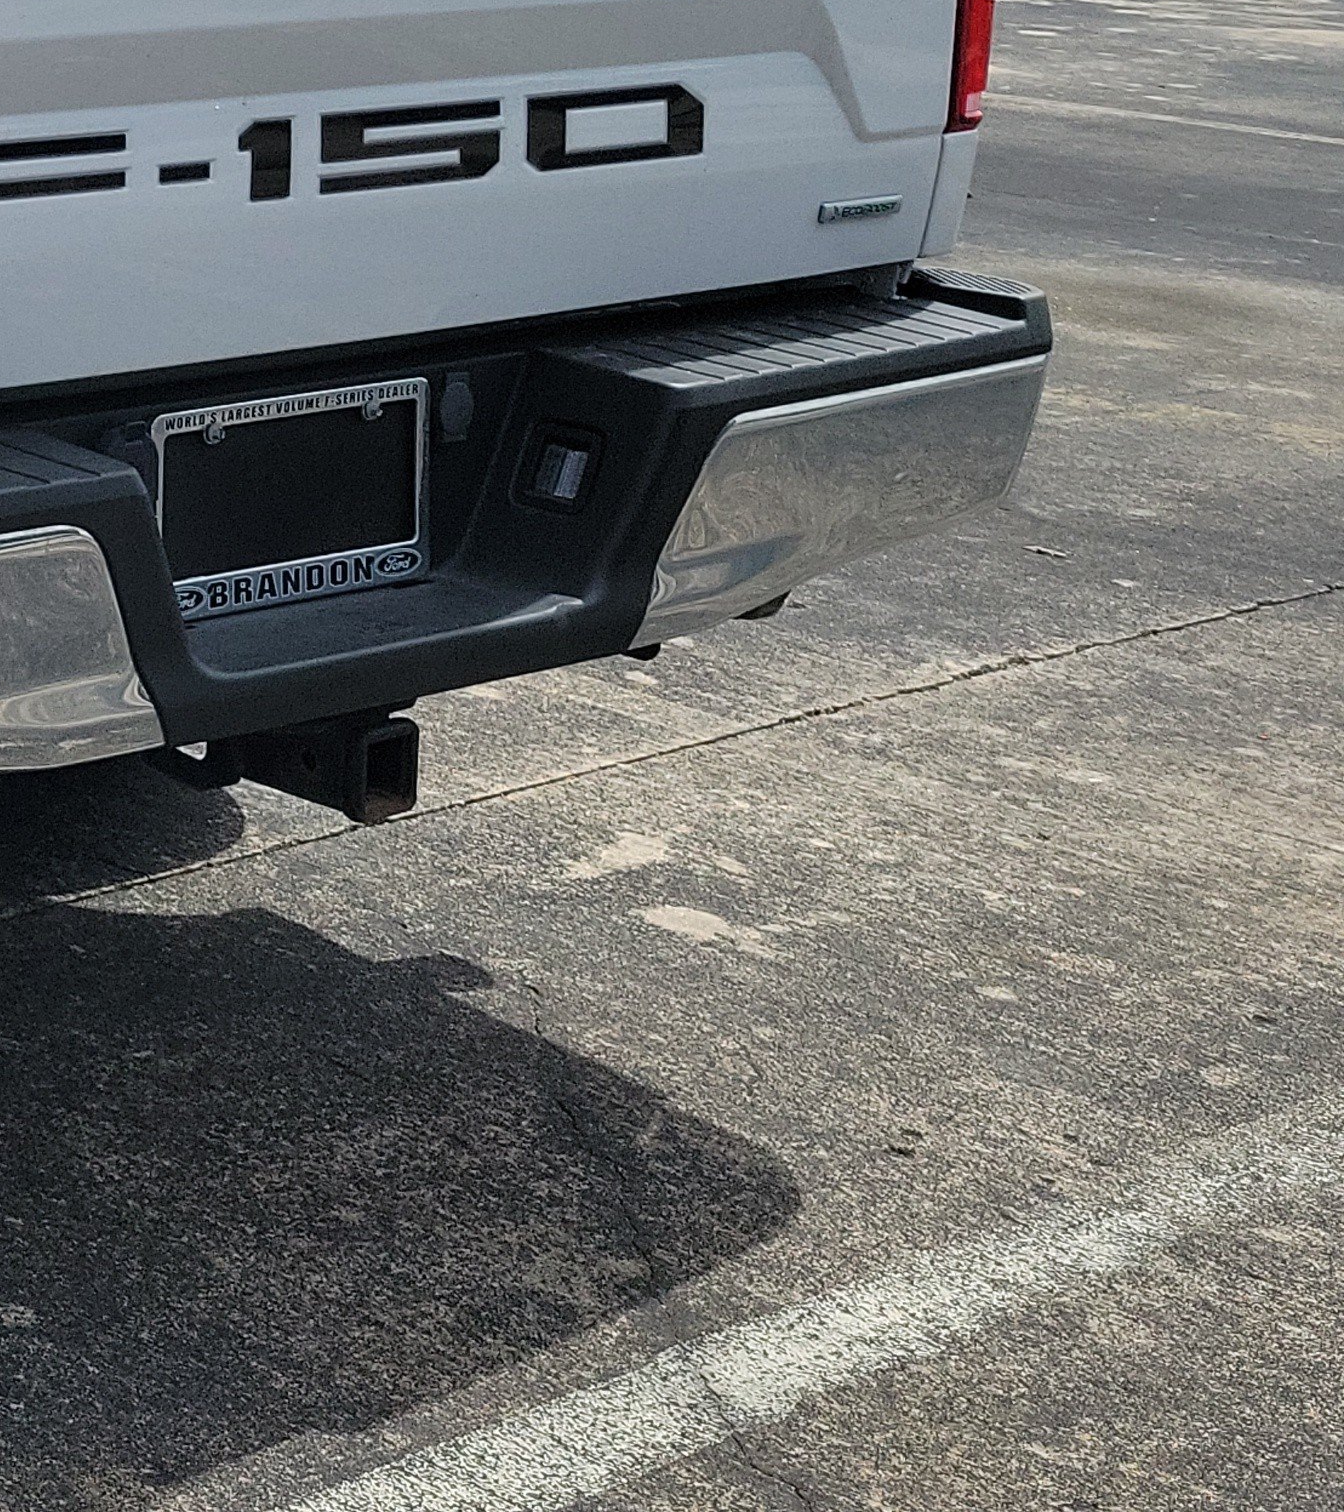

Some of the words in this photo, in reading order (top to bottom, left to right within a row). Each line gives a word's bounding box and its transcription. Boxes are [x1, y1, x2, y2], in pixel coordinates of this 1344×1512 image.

[165, 411, 217, 431] WORLD'S
[221, 403, 272, 422] LARGEST
[276, 396, 321, 414] VOLUME
[324, 387, 375, 408] F-SERIES
[378, 383, 419, 399] DEALER
[207, 555, 376, 610] BRANDON
[382, 555, 413, 573] Ford
